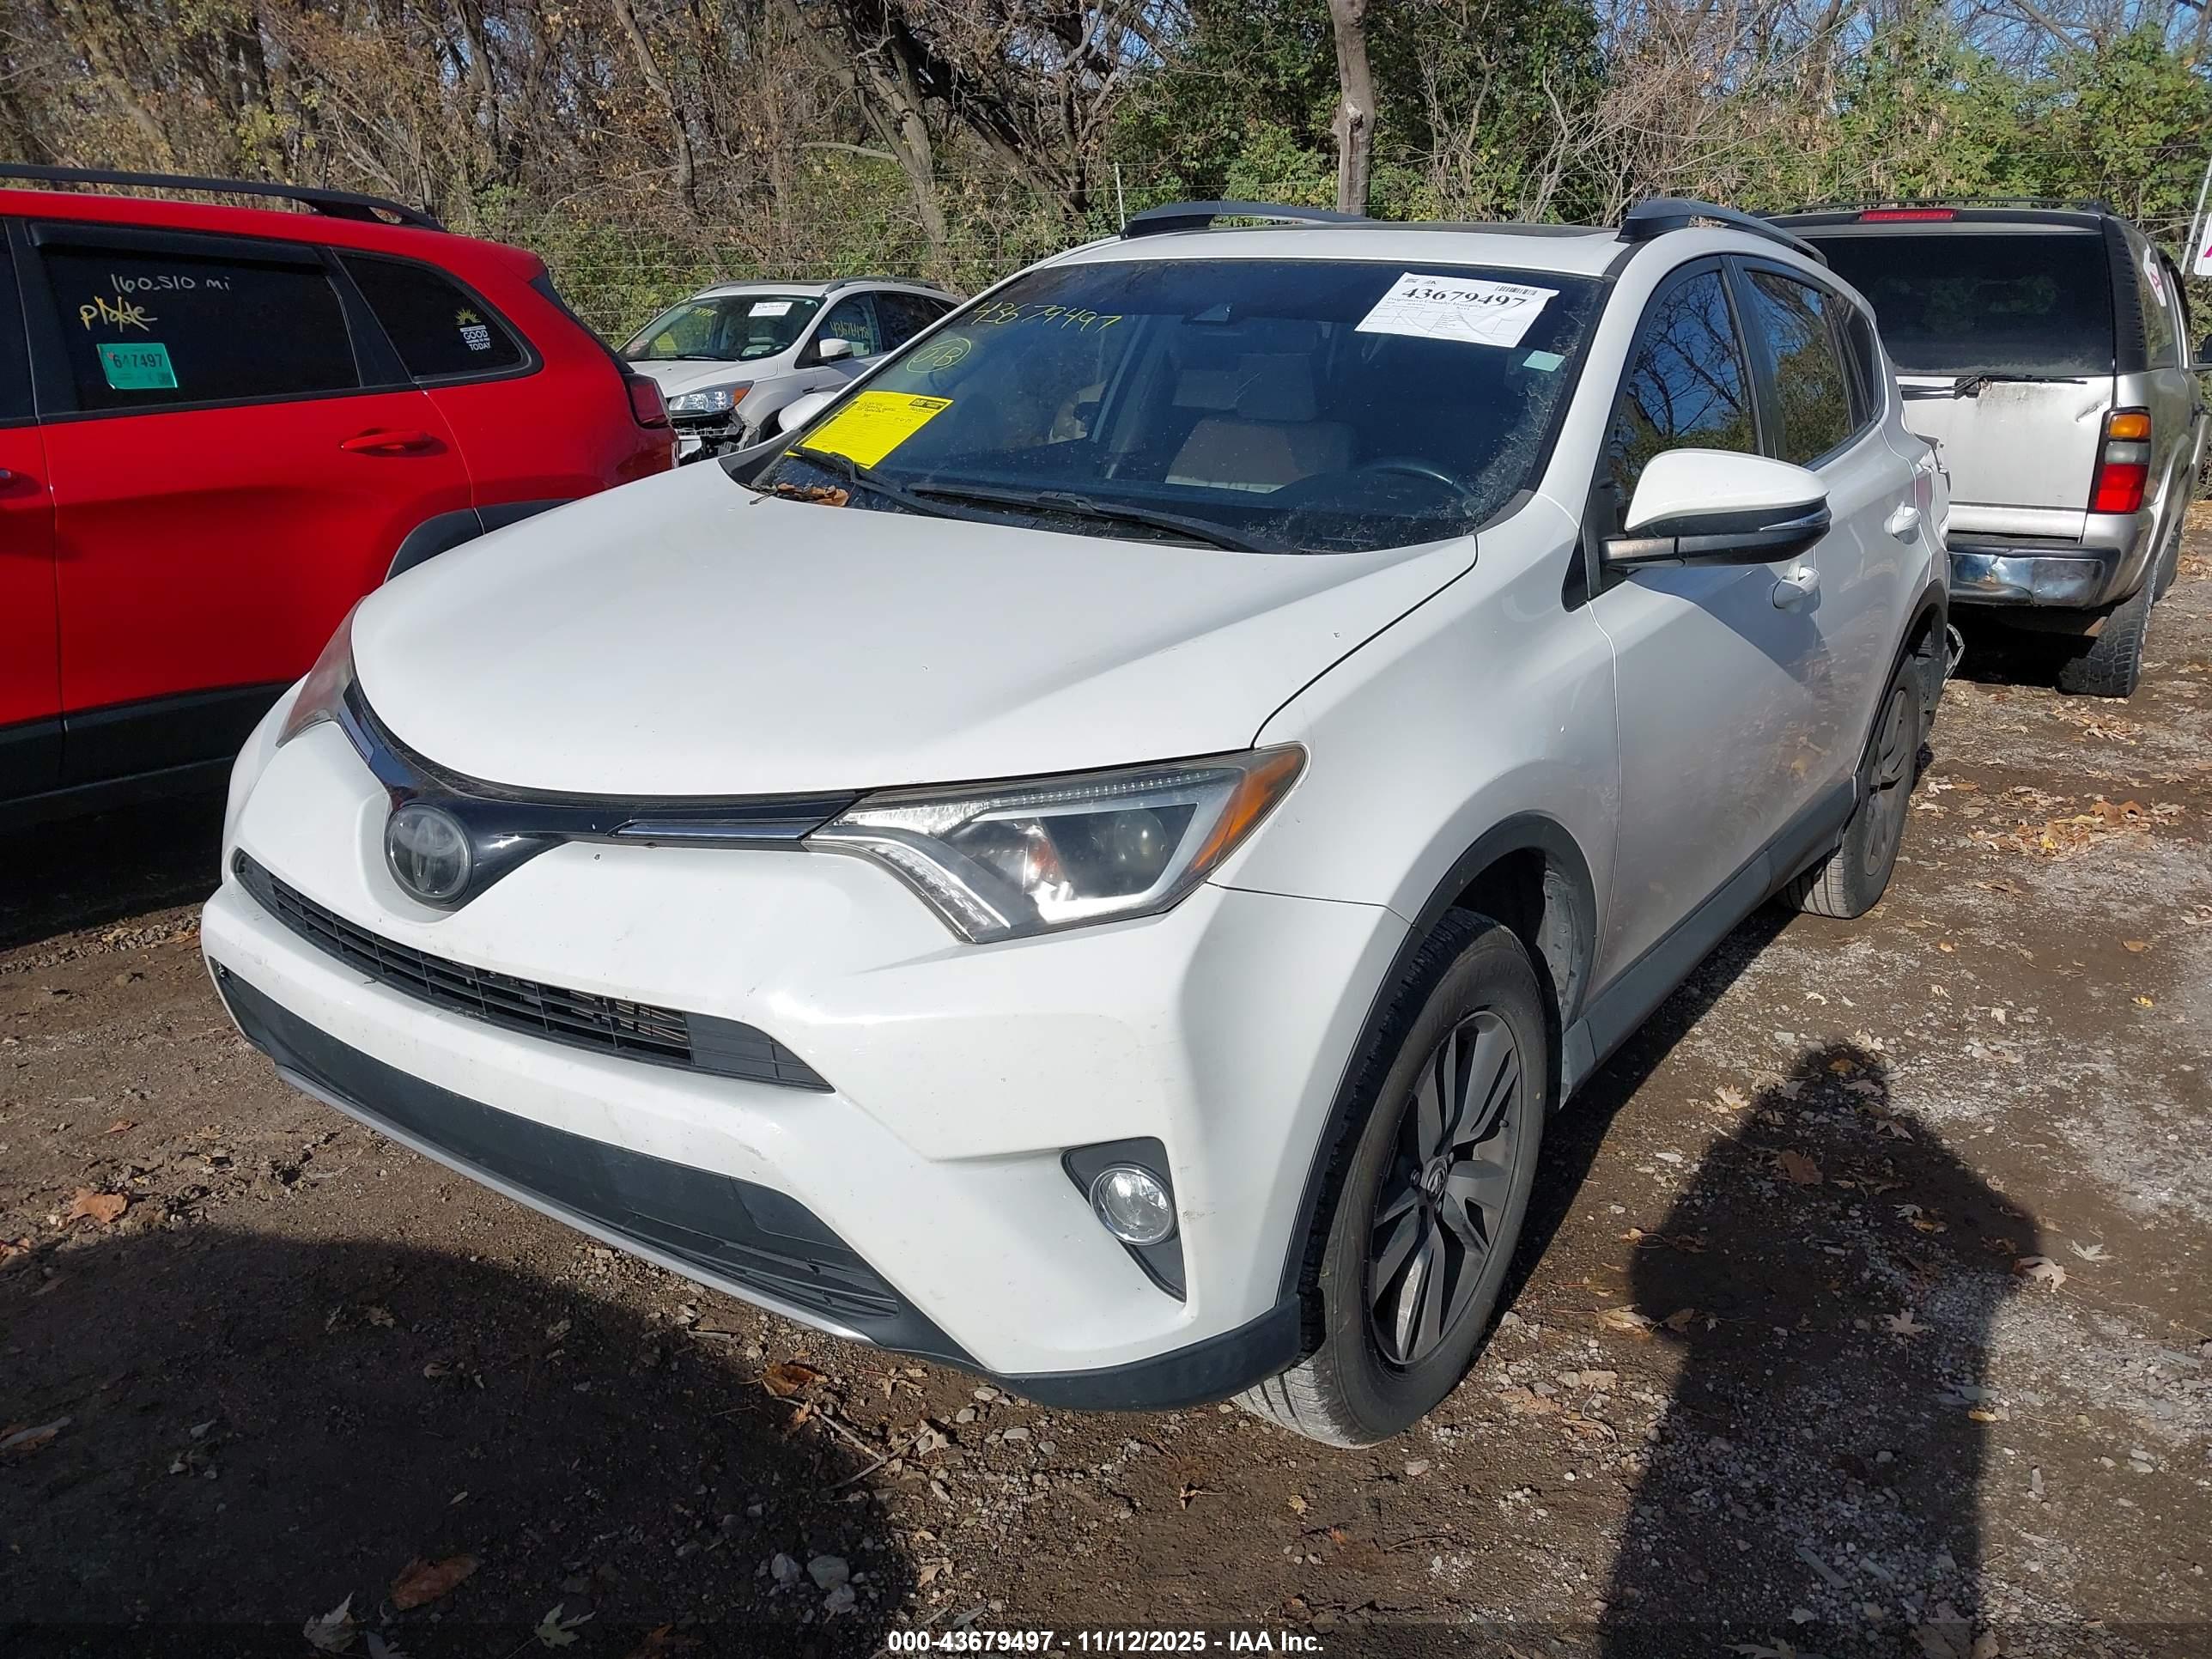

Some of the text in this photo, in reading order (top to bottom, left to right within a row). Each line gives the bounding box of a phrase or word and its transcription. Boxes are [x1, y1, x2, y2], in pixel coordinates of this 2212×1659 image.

[206, 276, 230, 290] mi
[1401, 288, 1528, 309] 43679497
[464, 329, 489, 340] GOOD
[469, 341, 490, 351] TODAY
